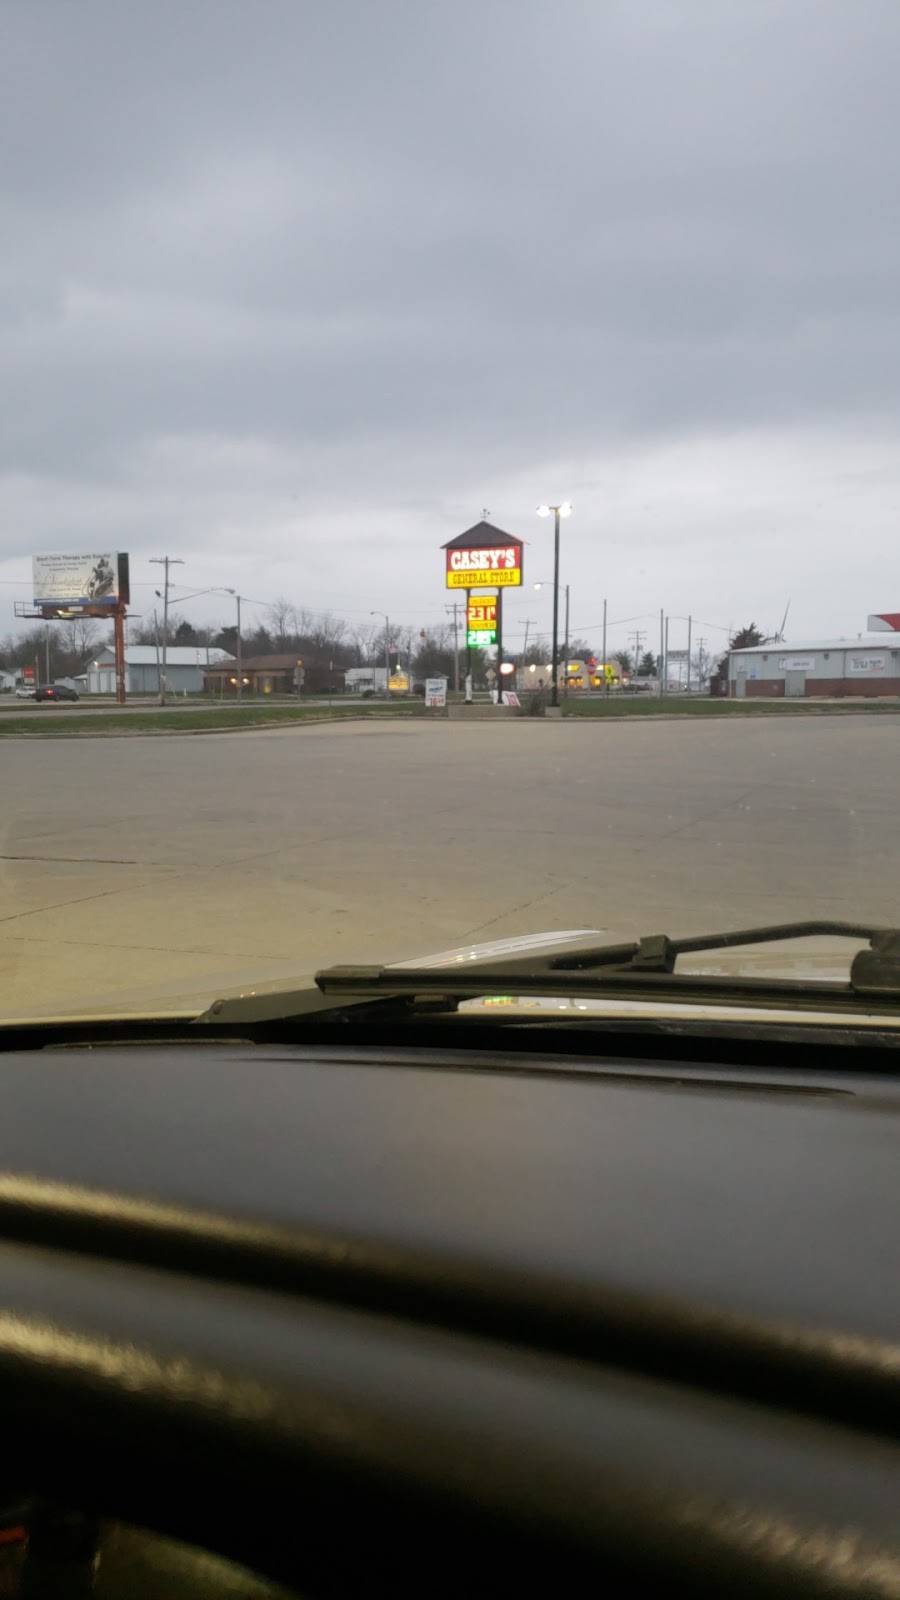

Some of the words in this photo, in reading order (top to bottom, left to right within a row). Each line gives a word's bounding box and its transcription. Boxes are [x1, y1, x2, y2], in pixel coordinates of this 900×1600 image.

[451, 548, 516, 571] CASEY'S
[453, 572, 488, 585] GENERAL
[490, 571, 514, 583] STORE
